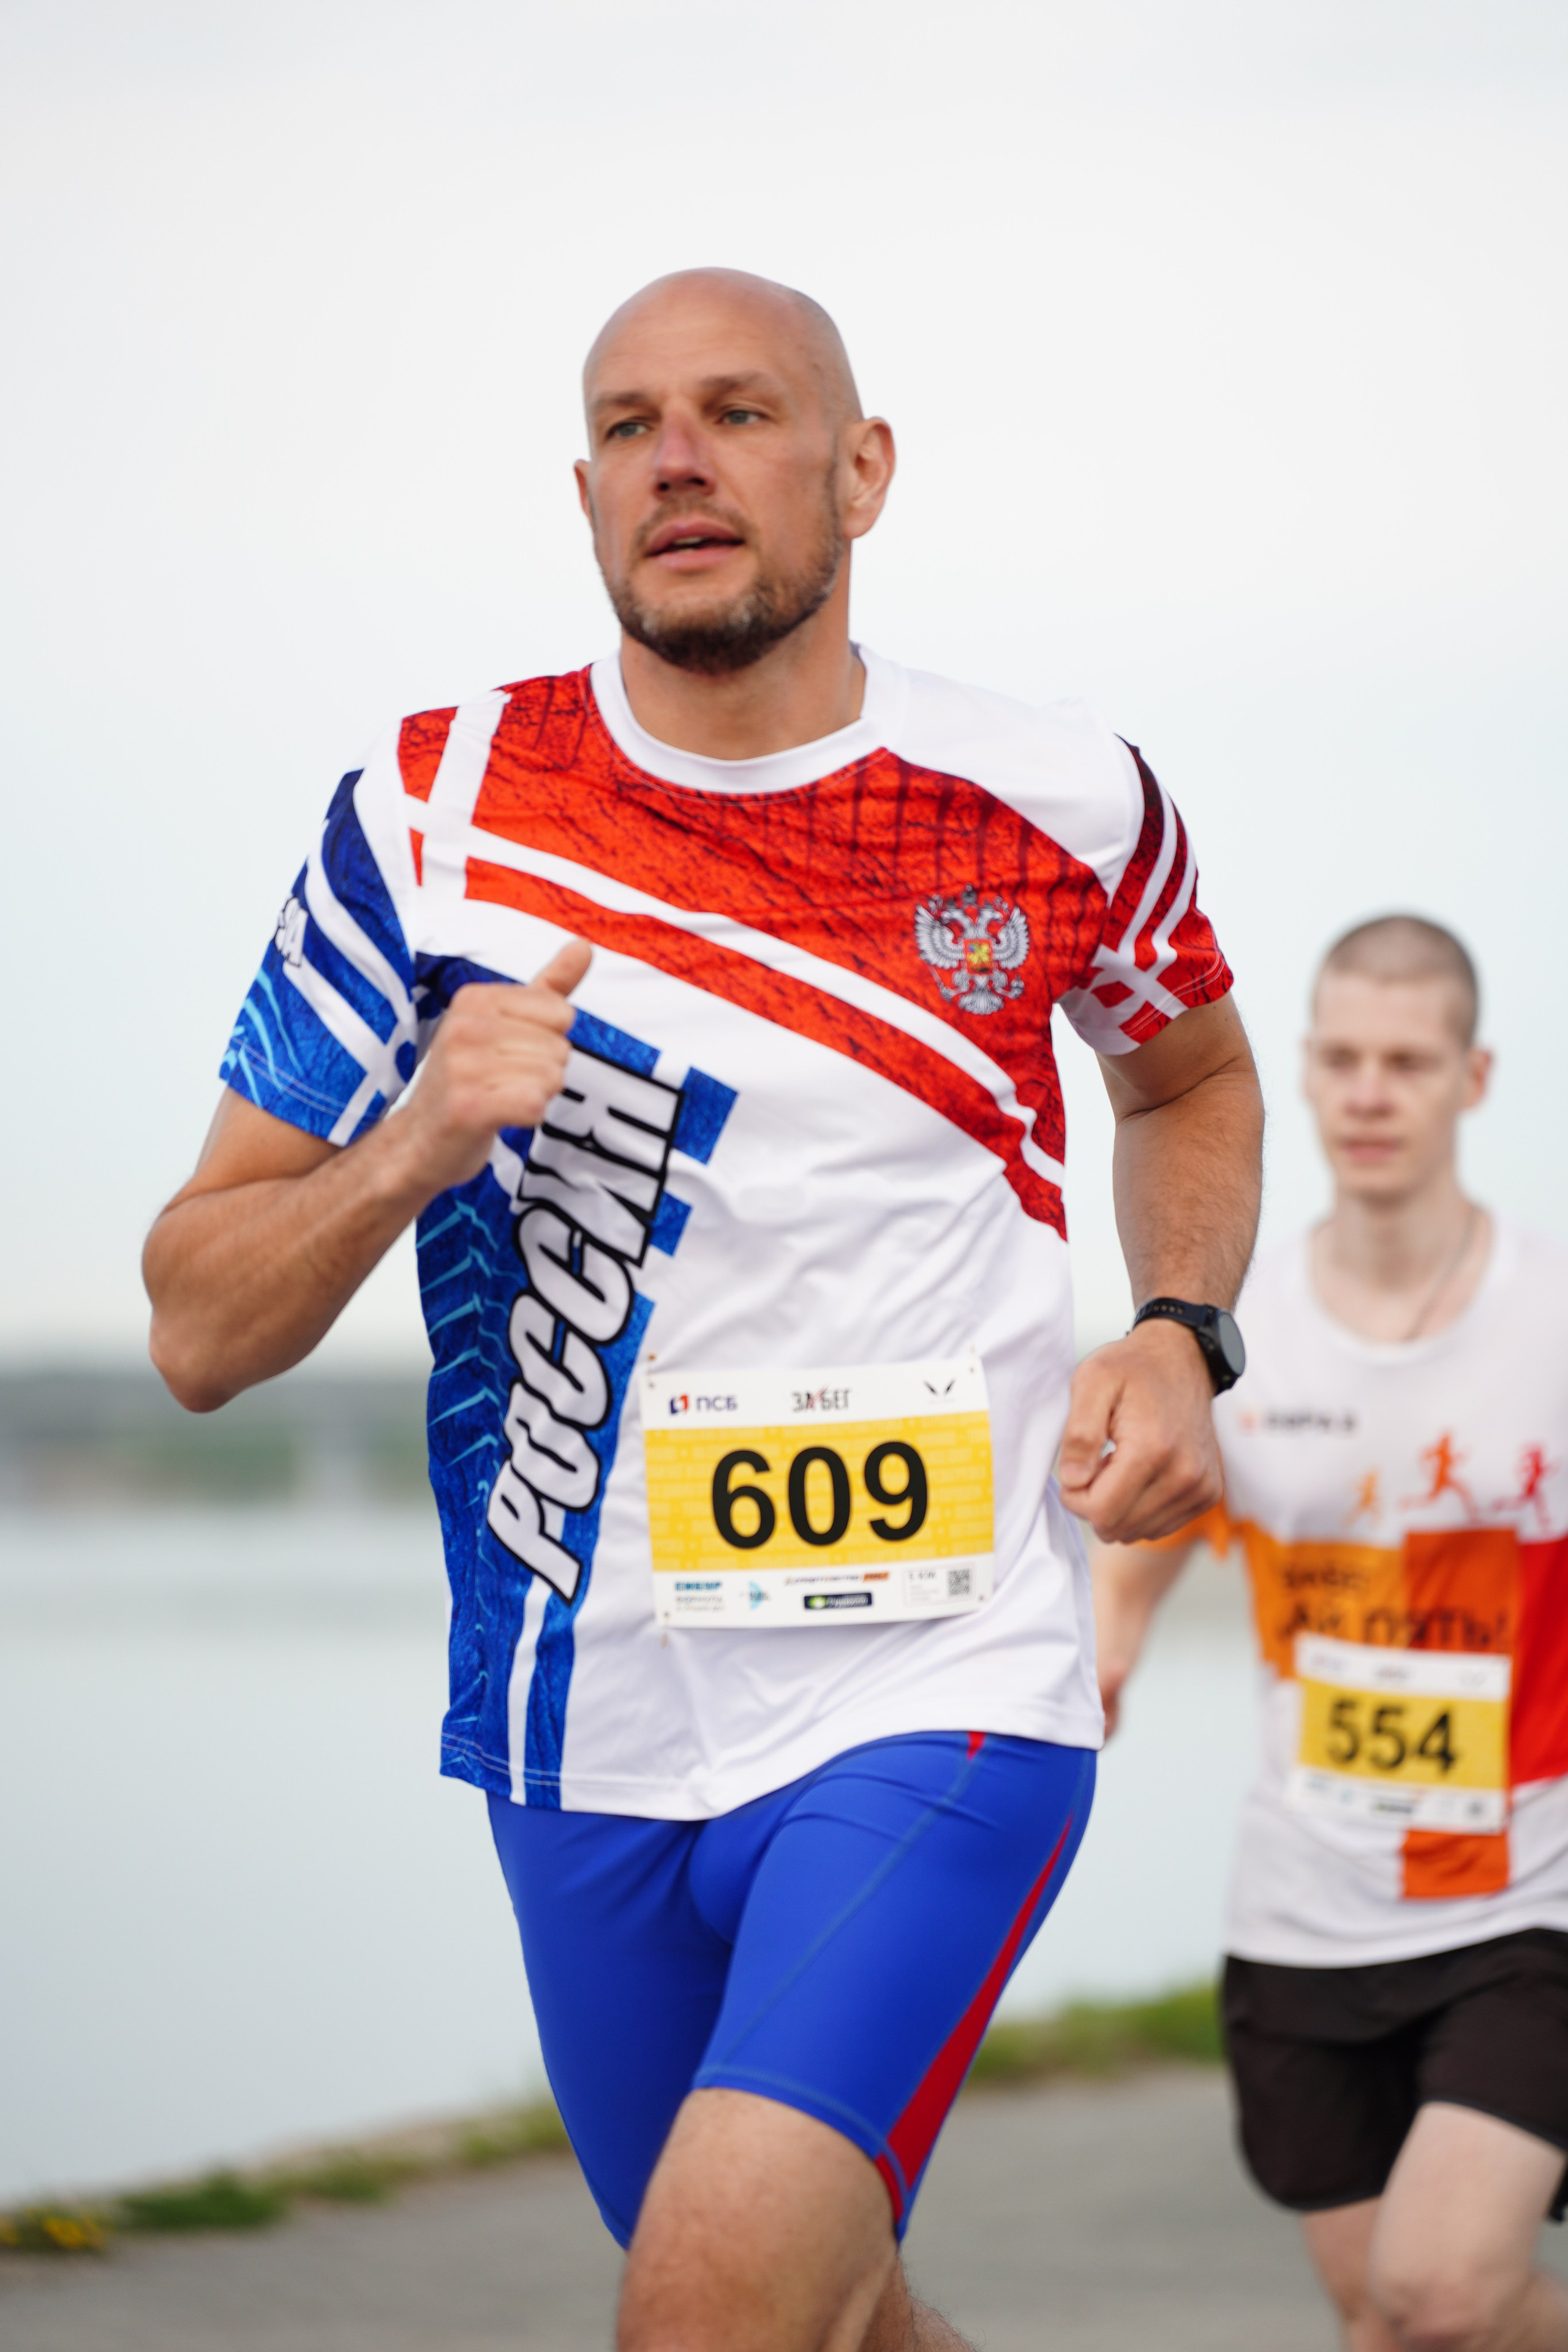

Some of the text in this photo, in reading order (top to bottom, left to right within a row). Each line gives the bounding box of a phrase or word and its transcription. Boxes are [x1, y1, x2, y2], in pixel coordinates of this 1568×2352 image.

[488, 1042, 681, 1605] РОССИЯ
[696, 1394, 738, 1412] ПСБ
[712, 1441, 928, 1550] 609
[1327, 1699, 1458, 1774] 554
